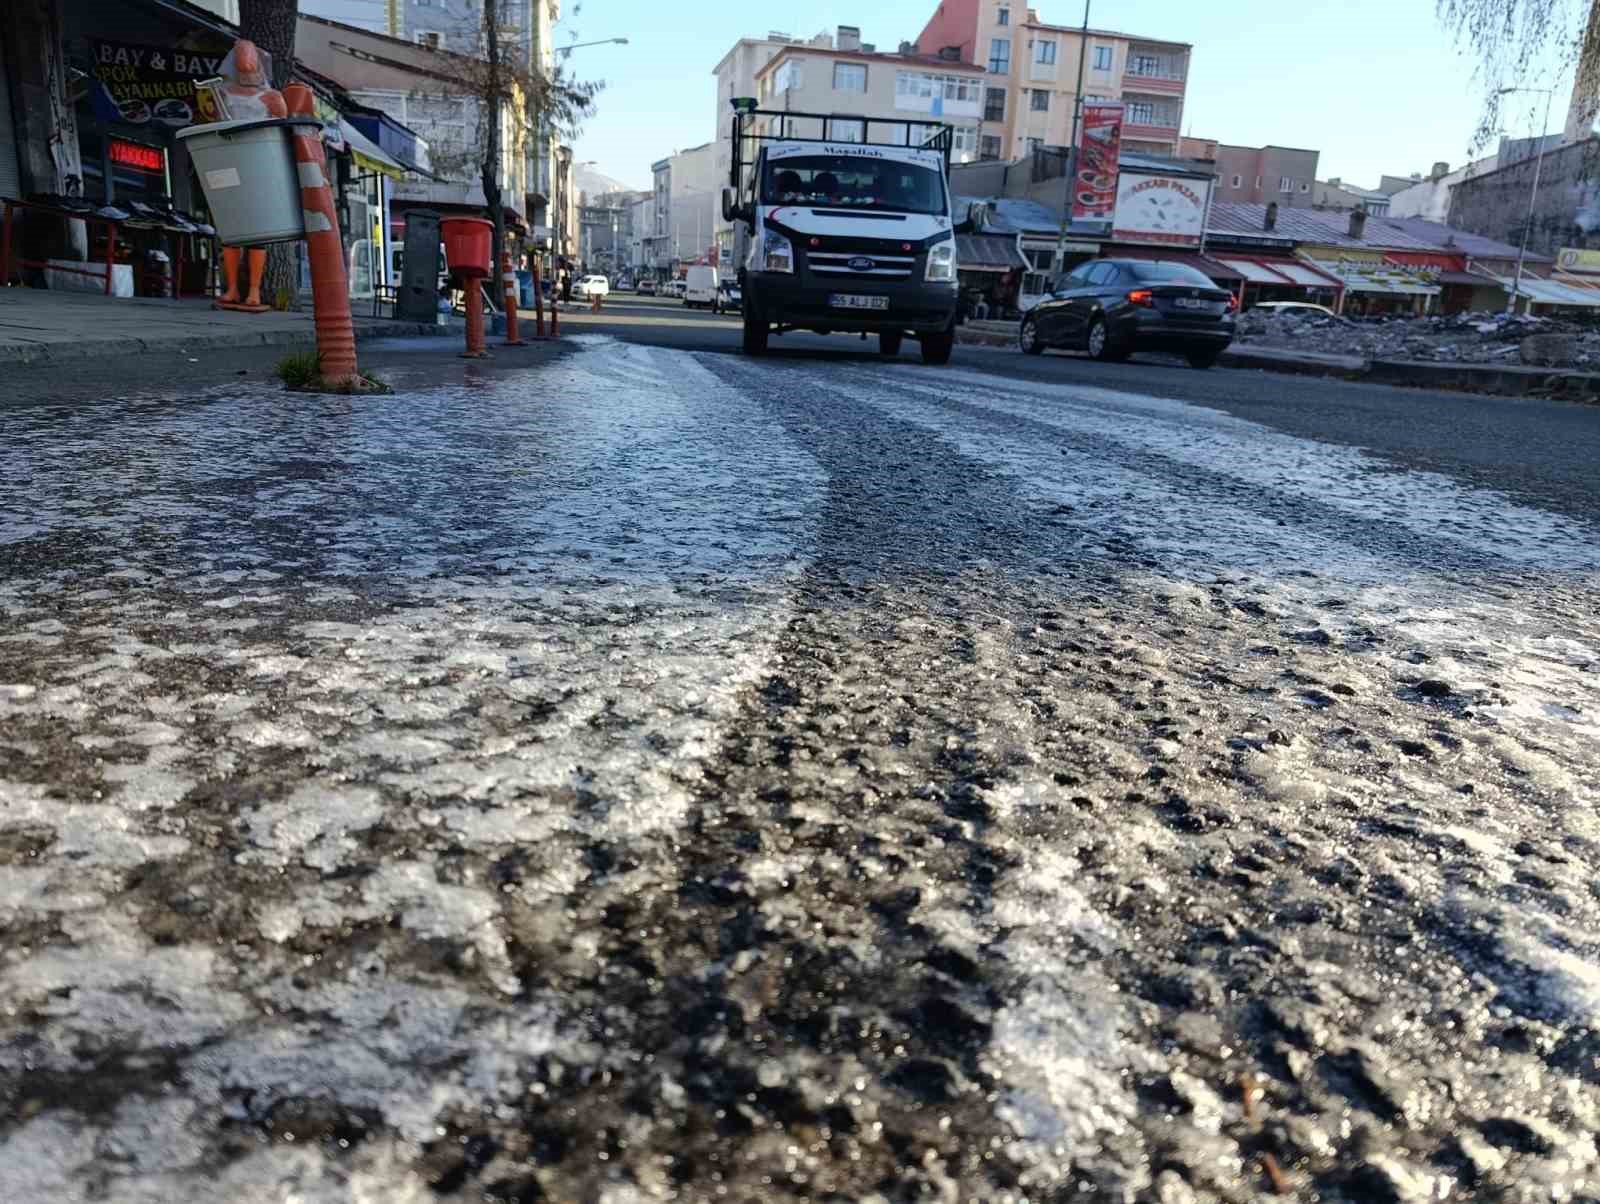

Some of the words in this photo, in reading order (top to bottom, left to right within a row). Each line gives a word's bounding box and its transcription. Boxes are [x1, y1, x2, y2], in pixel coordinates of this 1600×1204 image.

[100, 43, 144, 67] BAY
[150, 51, 168, 72] &
[175, 54, 220, 76] BAY
